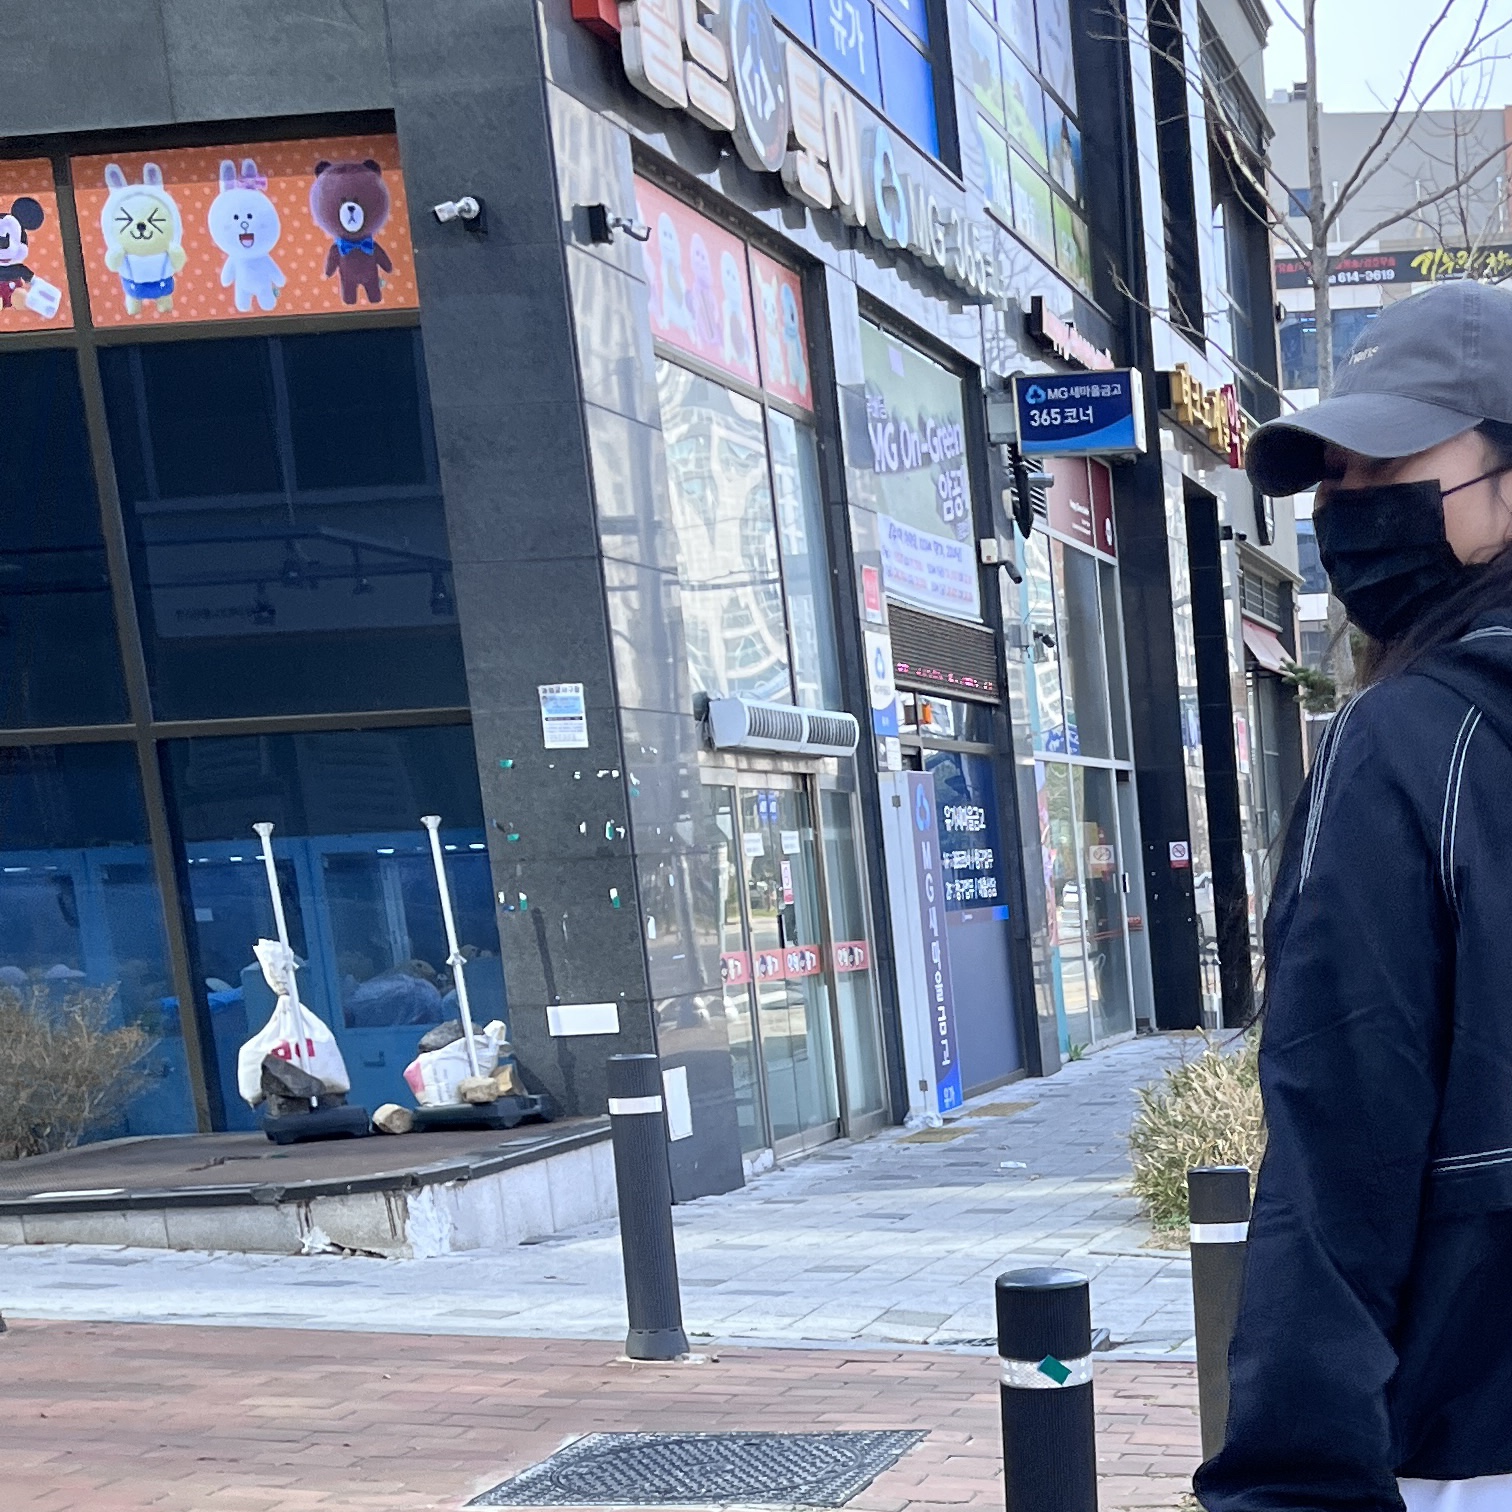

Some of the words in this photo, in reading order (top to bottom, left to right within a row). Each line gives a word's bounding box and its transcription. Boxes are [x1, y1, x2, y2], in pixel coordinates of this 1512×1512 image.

[906, 173, 946, 267] MG
[1030, 408, 1061, 427] 365
[1063, 405, 1093, 424] 코너
